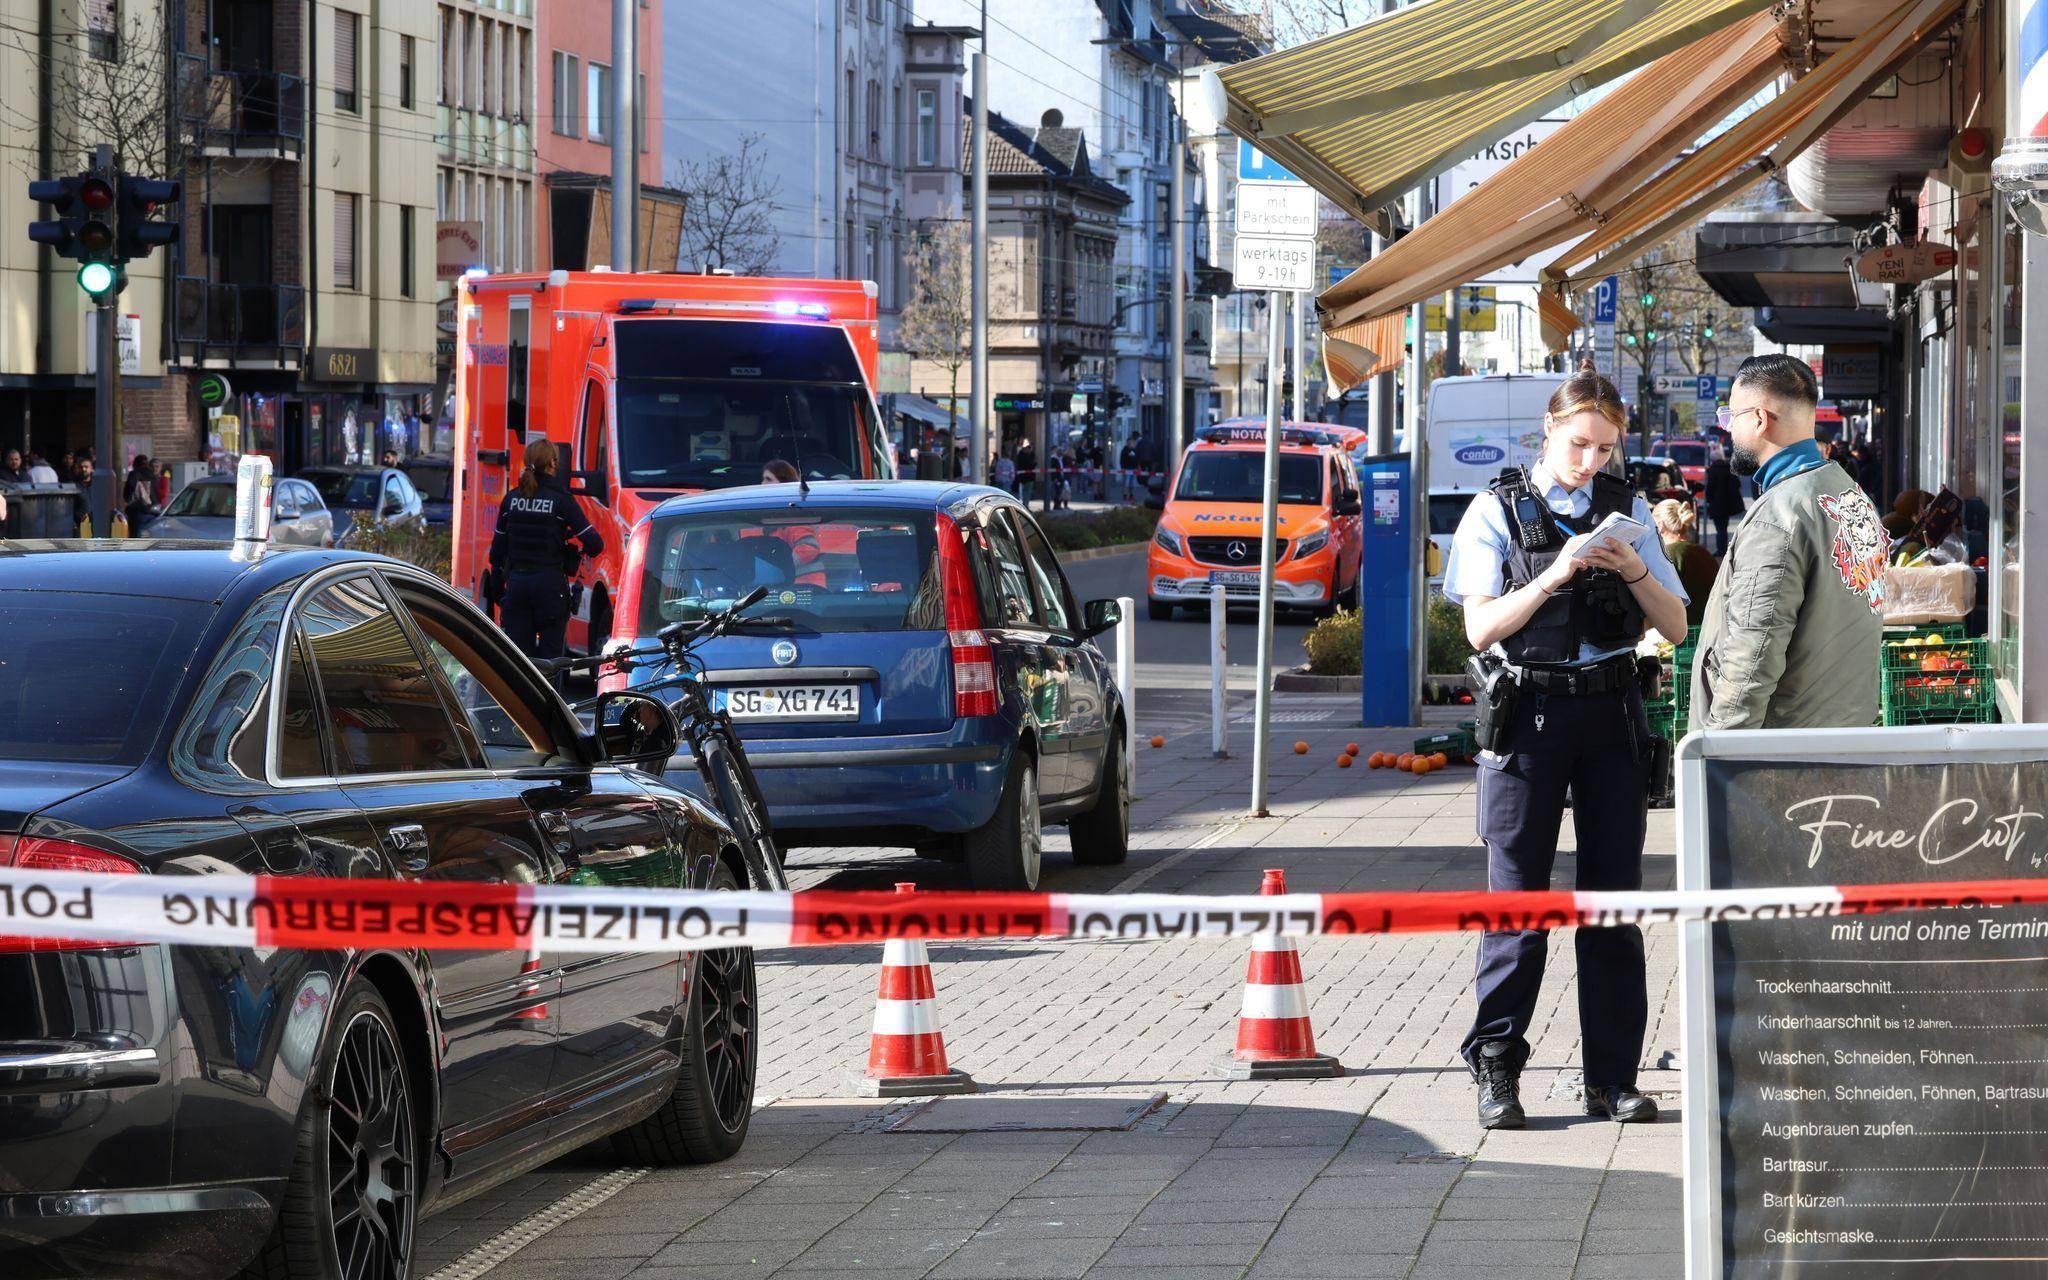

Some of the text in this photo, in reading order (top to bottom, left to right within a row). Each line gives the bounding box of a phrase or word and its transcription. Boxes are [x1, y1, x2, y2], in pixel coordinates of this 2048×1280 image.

[1268, 198, 1286, 208] mit
[1243, 211, 1310, 224] Parkschein
[1242, 248, 1307, 265] werktags
[329, 354, 357, 376] 6821
[1031, 400, 1044, 408] End
[510, 498, 554, 514] POLIZEI
[1193, 513, 1288, 525] Notart
[1215, 573, 1226, 582] SG
[1229, 573, 1240, 582] SG
[776, 649, 793, 658] FIAT
[731, 688, 856, 713] SG XG 741
[1784, 794, 2045, 869] Fine Cut
[2030, 852, 2042, 869] by
[162, 890, 749, 942] POLIZEIABSPERRUNG
[1831, 921, 1864, 941] mit
[1869, 920, 1911, 941] und
[1916, 919, 1971, 941] ohne
[1755, 979, 1892, 994] Trockenhaarschnitt
[1757, 1014, 1952, 1030] Kinderhaarschnit bis 12 Jahren
[1758, 1048, 1975, 1067] Waschen, Schneiden, Föhnen
[1760, 1086, 1831, 1102] Waschen,
[1834, 1085, 1917, 1102] Schneiden,
[1921, 1084, 1981, 1102] Föhnen,
[1761, 1120, 1914, 1140] Augenbrauen zupfen
[1762, 1157, 1828, 1173] Bartrasur
[1763, 1192, 1846, 1208] Bart kürzen
[1763, 1228, 1874, 1244] Gesichtsmaske
